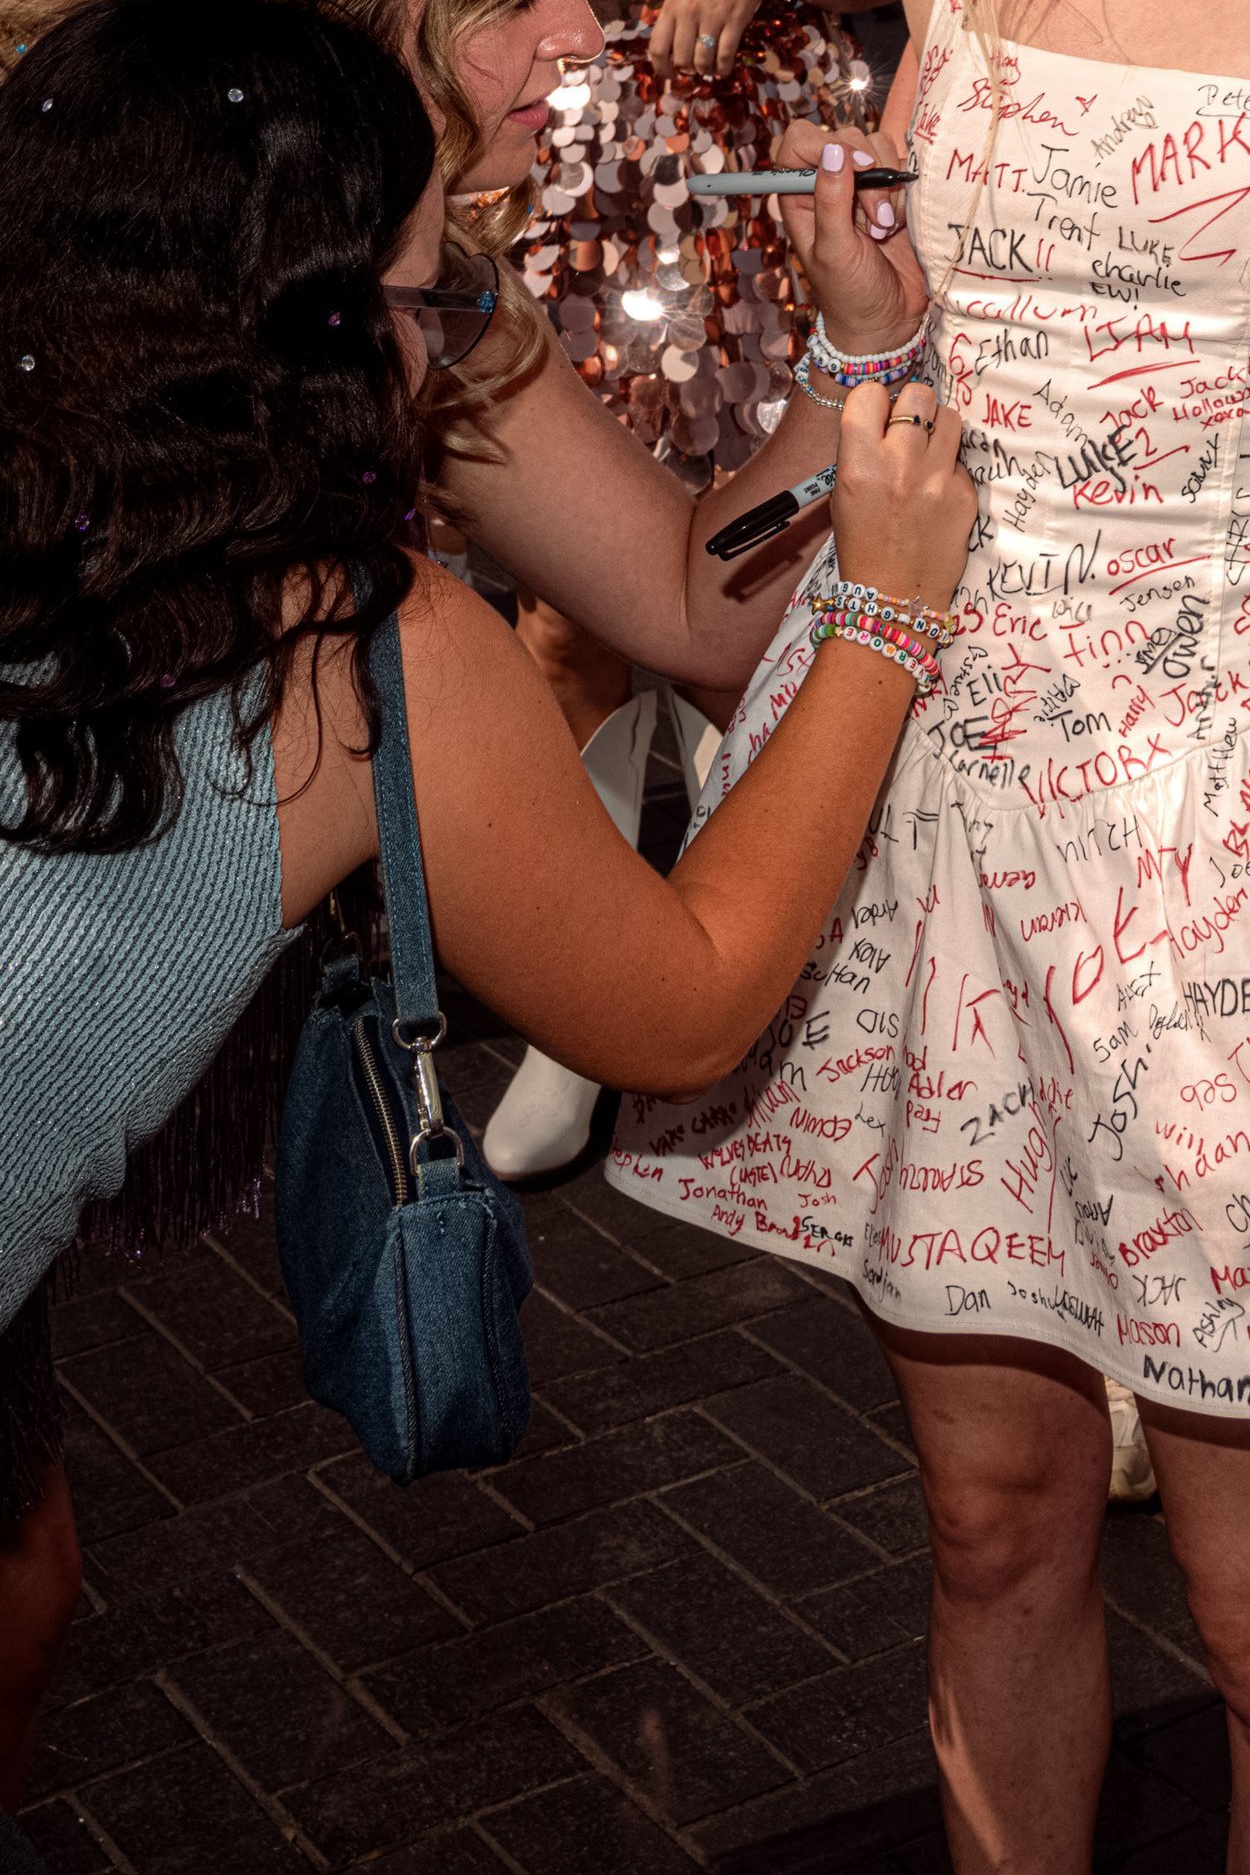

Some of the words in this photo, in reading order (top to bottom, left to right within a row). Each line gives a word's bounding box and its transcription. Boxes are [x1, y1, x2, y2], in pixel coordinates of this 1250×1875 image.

[1030, 144, 1118, 209] Jamie
[1026, 192, 1101, 251] Trent
[974, 328, 1049, 376] Ethan
[981, 392, 1033, 433] JAKE
[1032, 378, 1089, 449] Adam
[1119, 574, 1198, 612] Jensen
[992, 602, 1049, 643] Eric
[1162, 594, 1212, 680] Owen
[965, 664, 1004, 707] Eli
[1045, 709, 1113, 744] Tom
[849, 936, 892, 975] Alex
[815, 1045, 896, 1083] Jackson
[678, 1177, 768, 1211] Jonathan
[797, 1191, 838, 1209] Josh
[944, 1284, 992, 1316] Dan
[1131, 1274, 1187, 1308] JACK
[1116, 1313, 1181, 1348] Mason
